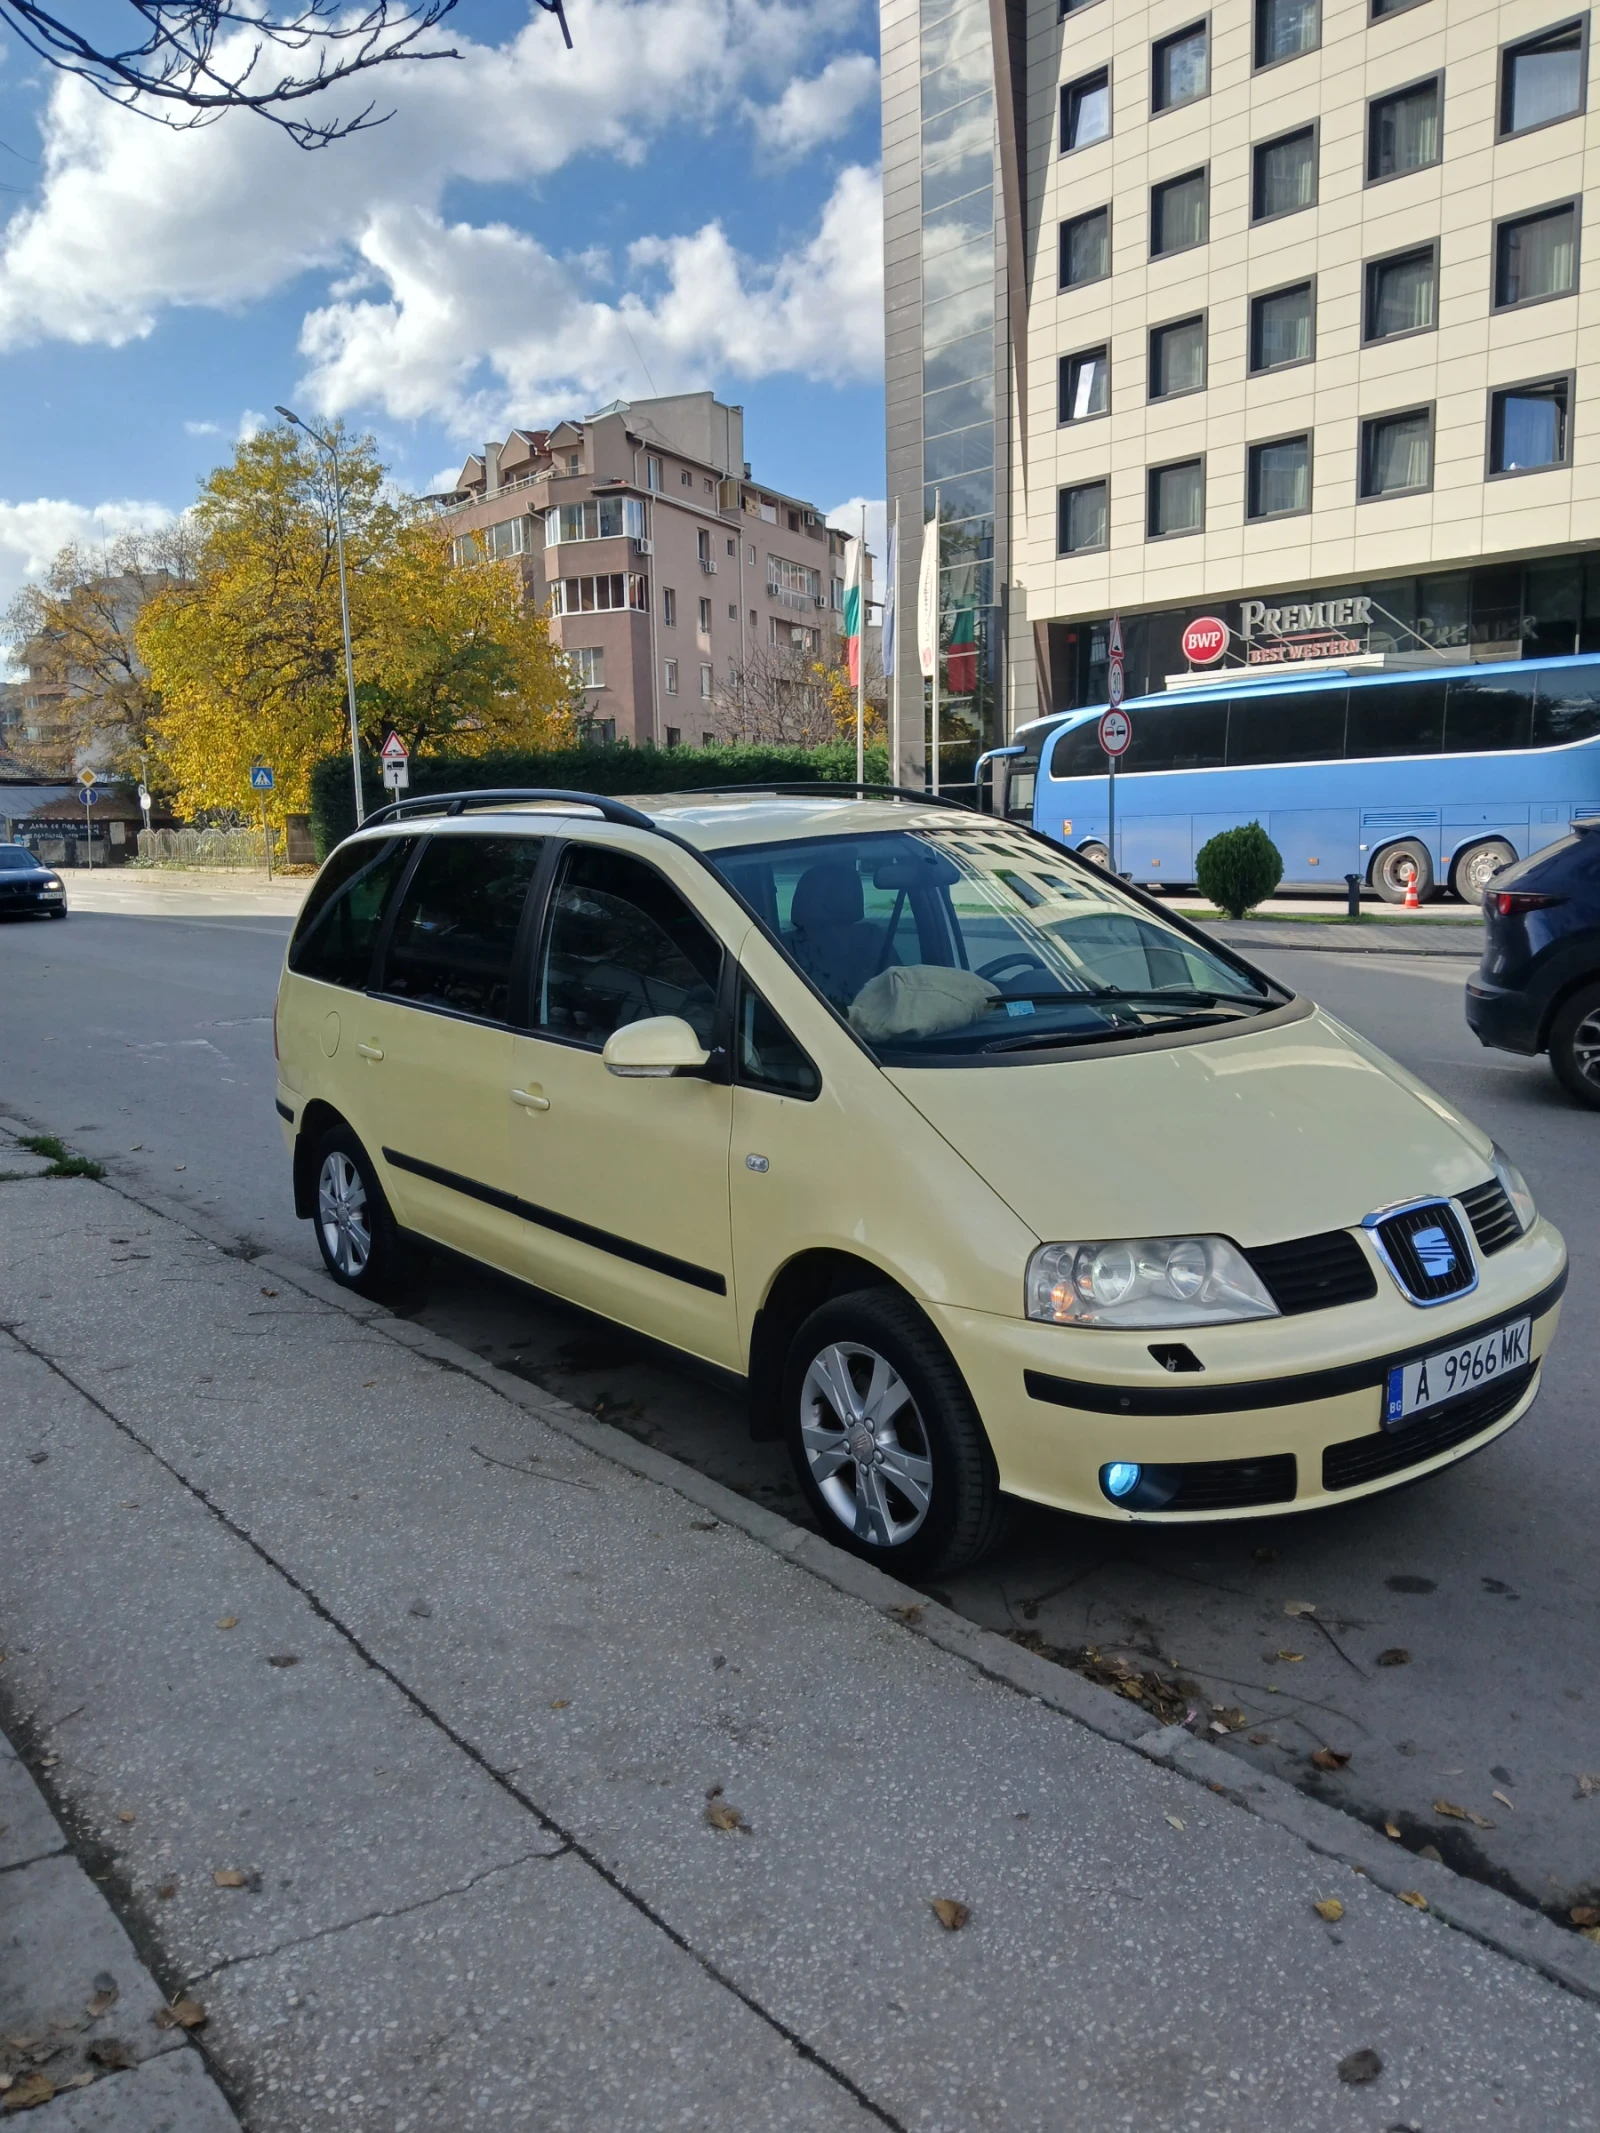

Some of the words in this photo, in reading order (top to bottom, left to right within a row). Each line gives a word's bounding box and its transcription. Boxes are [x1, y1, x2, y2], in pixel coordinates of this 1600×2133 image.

[1239, 596, 1374, 641] PREMIER
[1188, 631, 1221, 650] BWP
[1248, 648, 1286, 664] BEST
[1288, 639, 1361, 660] WESTERN
[1112, 671, 1121, 694] 30
[1444, 1339, 1497, 1392] 9966
[1501, 1324, 1526, 1368] MK
[1389, 1400, 1402, 1413] BG
